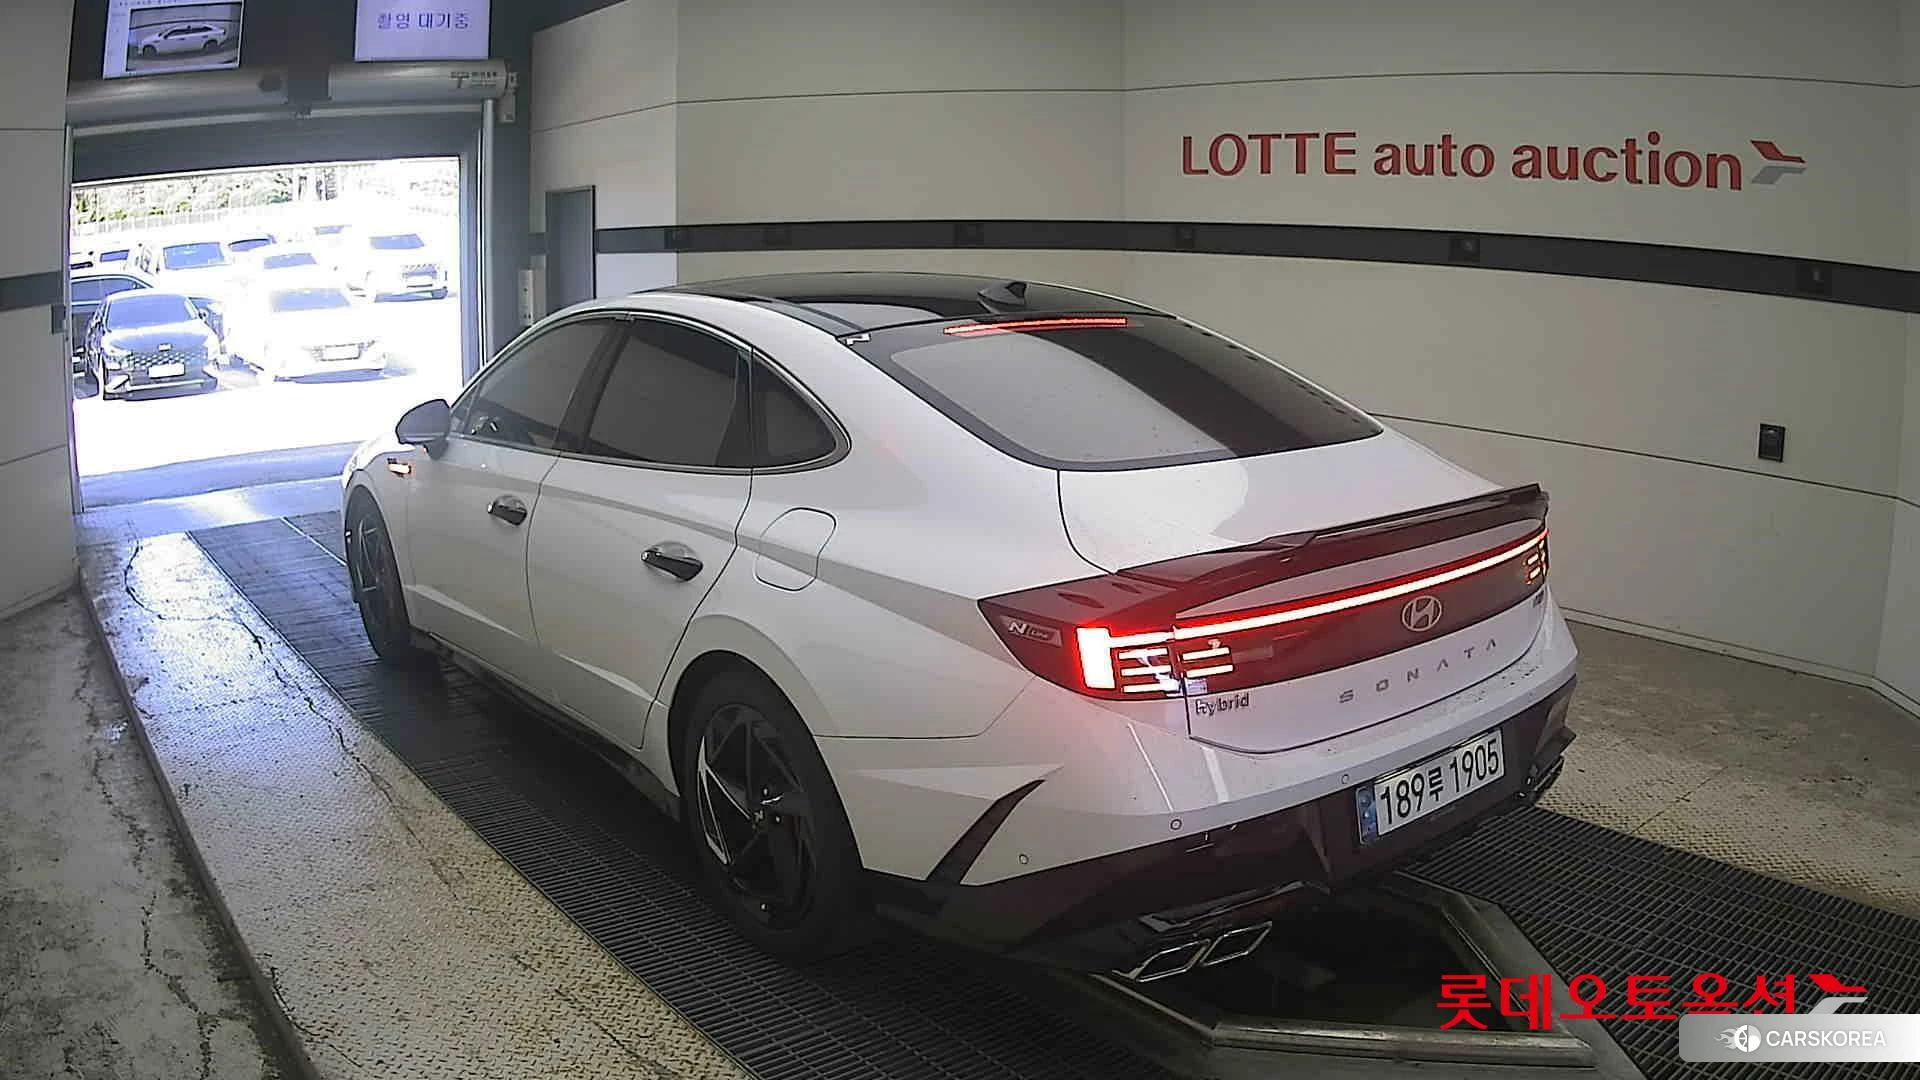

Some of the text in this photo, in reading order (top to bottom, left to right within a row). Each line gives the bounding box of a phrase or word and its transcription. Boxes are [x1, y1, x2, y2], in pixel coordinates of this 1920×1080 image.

[419, 12, 468, 29] 대기중
[1182, 131, 1742, 191] LOTTE auto auction
[1338, 638, 1497, 704] SONATA
[1381, 738, 1499, 825] 189루 1905
